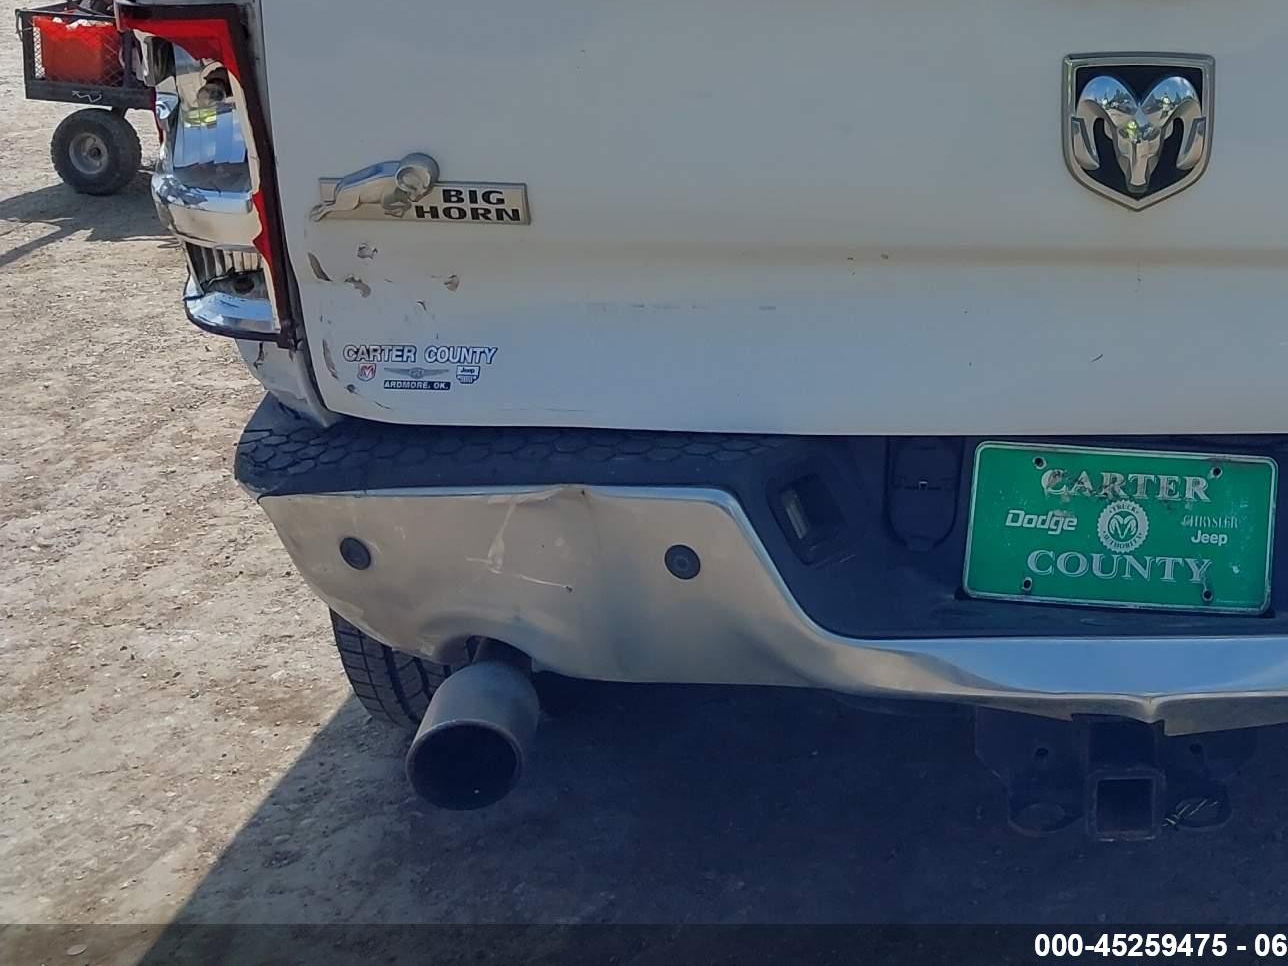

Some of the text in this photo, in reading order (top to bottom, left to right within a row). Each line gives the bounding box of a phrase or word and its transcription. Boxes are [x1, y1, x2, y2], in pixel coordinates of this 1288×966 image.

[442, 189, 505, 205] BIG
[415, 206, 520, 221] HORN
[343, 344, 498, 364] CARTER COUNTY
[1041, 469, 1211, 502] CARTER
[1006, 509, 1078, 535] Dodge
[1182, 514, 1238, 529] CHRYSLER
[1190, 530, 1229, 546] Jeep
[1027, 549, 1212, 583] COUNTY
